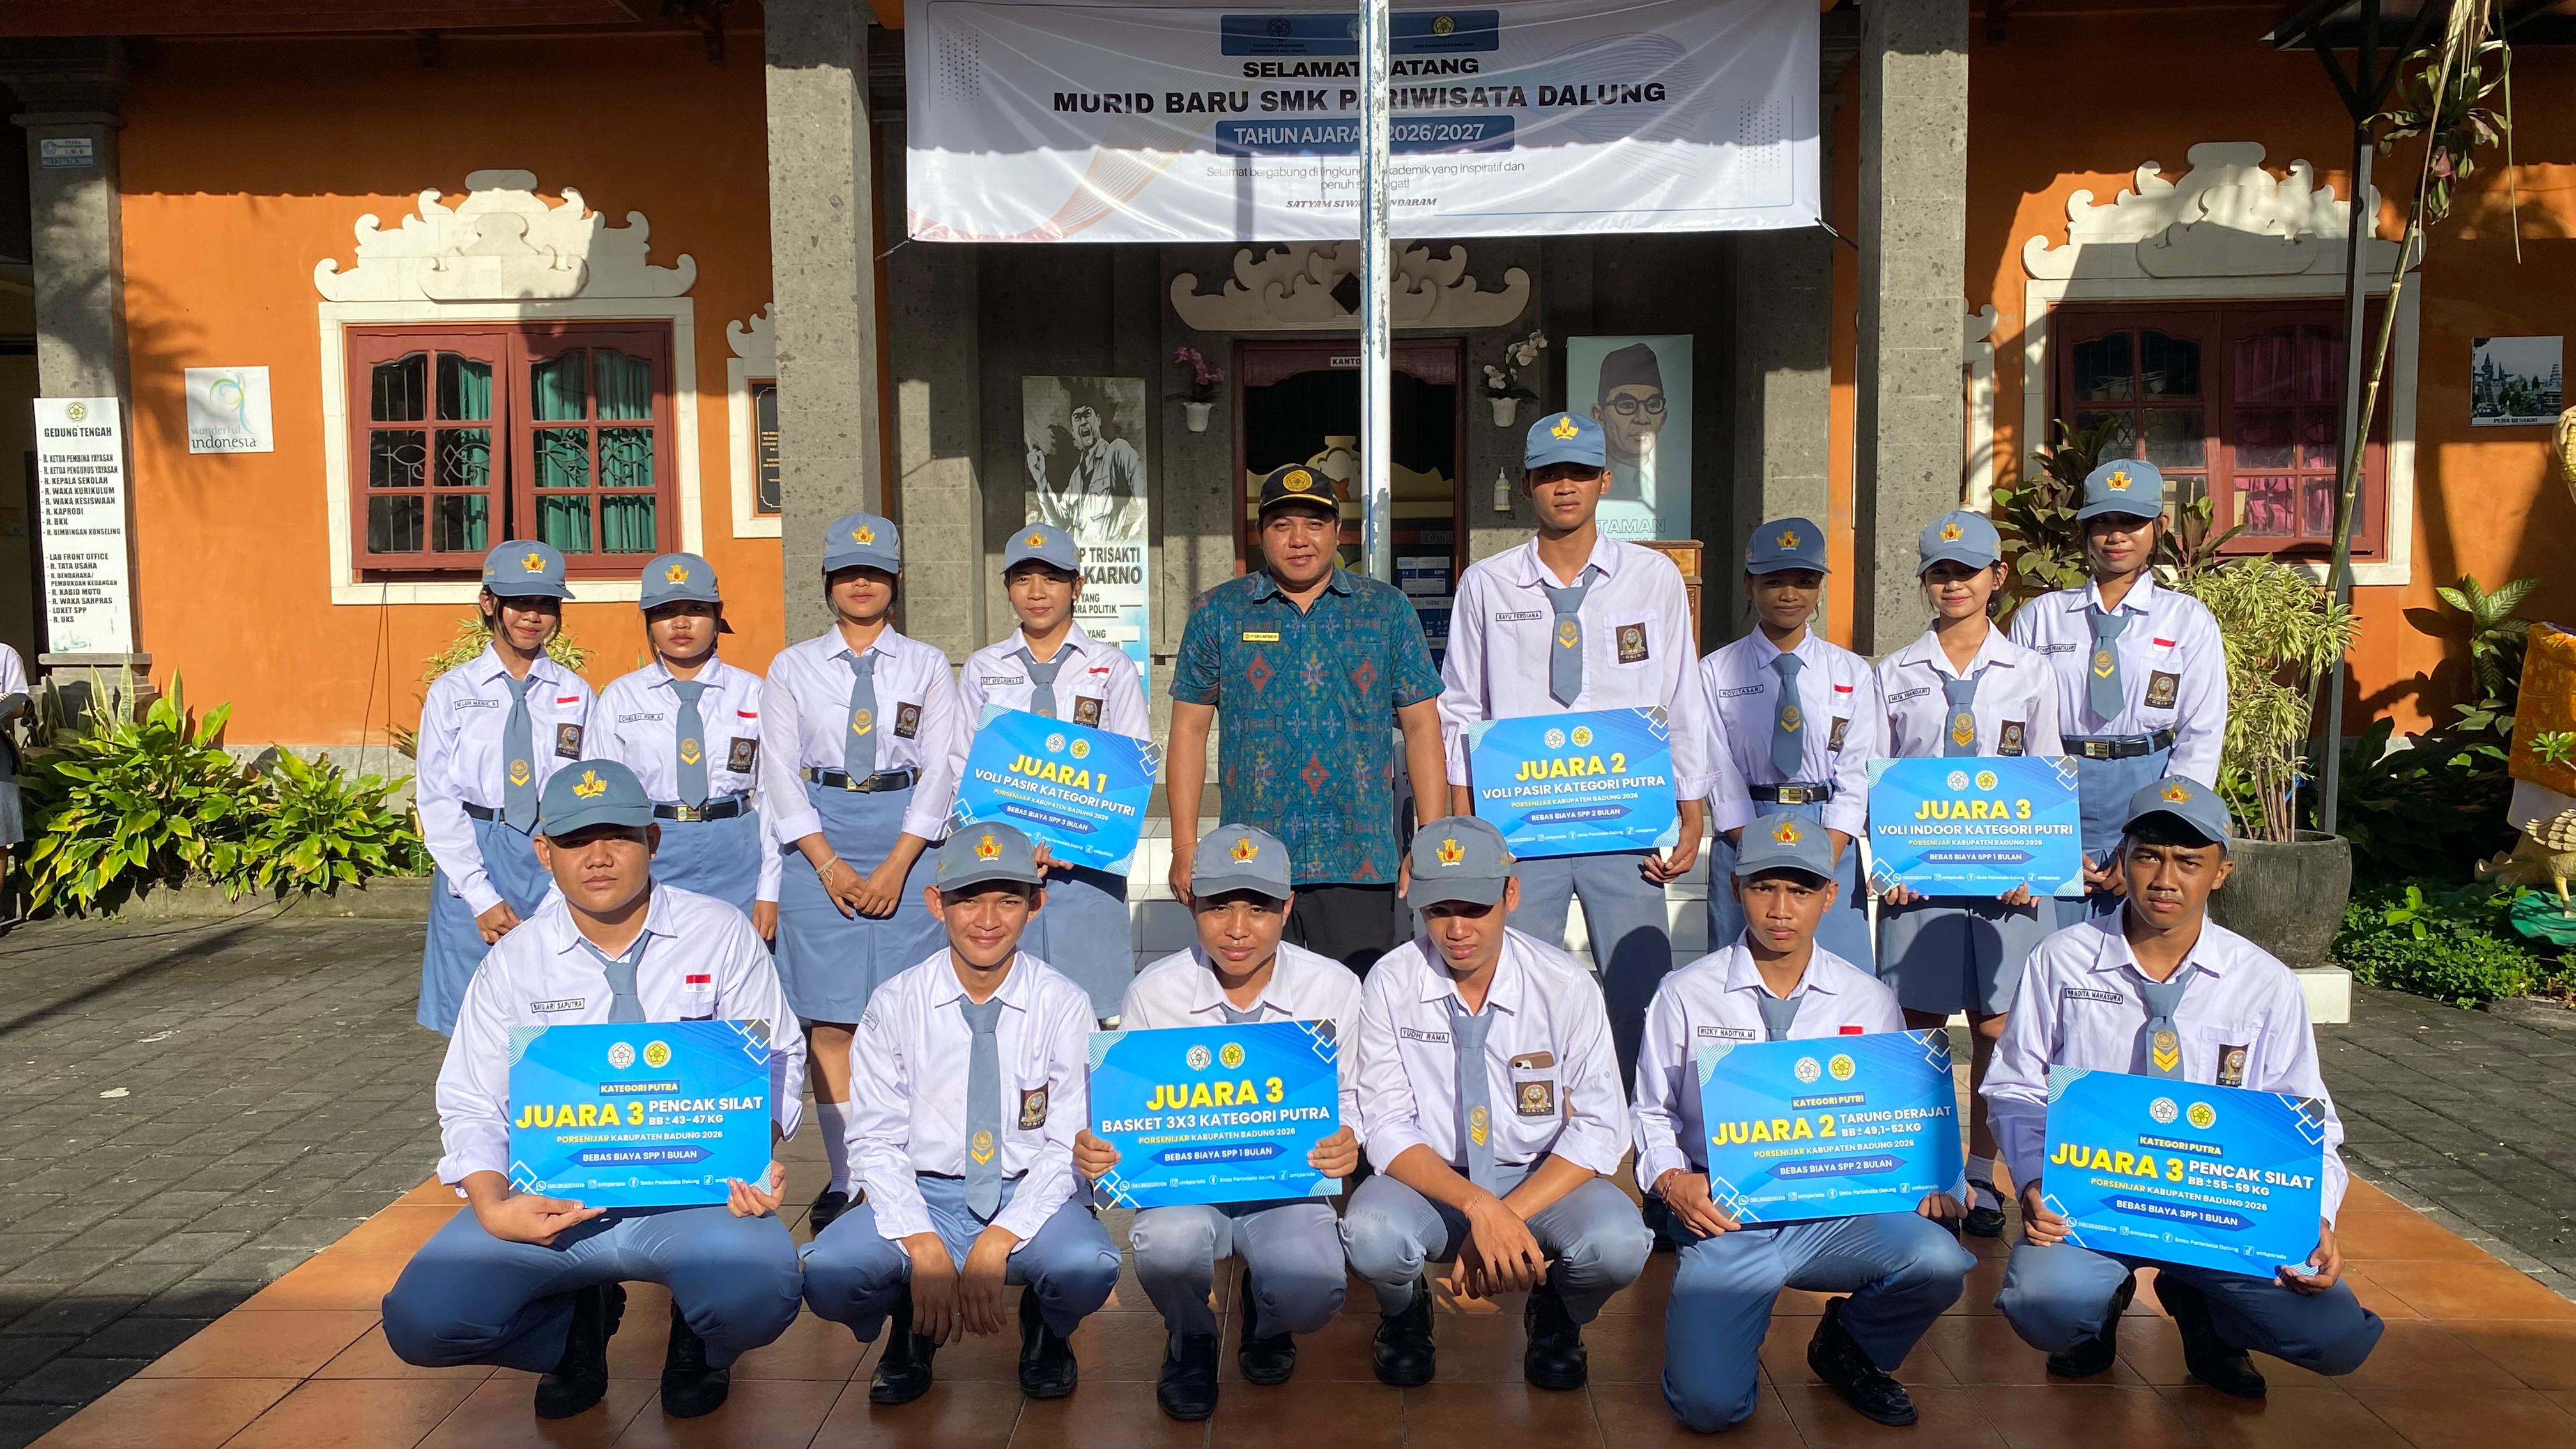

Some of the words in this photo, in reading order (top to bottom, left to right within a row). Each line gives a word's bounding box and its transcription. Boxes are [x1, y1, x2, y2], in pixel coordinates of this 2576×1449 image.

[1243, 61, 1360, 78] SELAMAT
[1389, 58, 1479, 75] ATANG
[1054, 92, 1154, 114] MURID
[1165, 91, 1248, 113] BARU
[1261, 89, 1328, 112] SMK
[1538, 82, 1666, 107] DALUNG
[1234, 126, 1300, 144] TAHUN
[1301, 125, 1360, 144] AJARA
[1207, 167, 1248, 177] Selamat
[1250, 167, 1307, 179] bergabung
[1309, 167, 1318, 177] di
[1389, 164, 1430, 175] kademik
[1432, 165, 1458, 176] yang
[1460, 162, 1503, 174] inspiratif
[1504, 161, 1524, 171] dan
[1321, 180, 1354, 192] penuh
[1389, 198, 1438, 206] NDARAM
[45, 428, 77, 437] GEDUNG
[80, 427, 112, 436] TENGAH
[192, 424, 241, 434] wonderful
[192, 435, 257, 448] indonesia
[1597, 519, 1666, 533] TAMAN
[1089, 547, 1140, 563] TRISAKTI
[1084, 565, 1143, 585] KARNO
[1081, 594, 1100, 602] YANG
[1089, 605, 1117, 614] POLITIK
[1087, 629, 1106, 638] YANG
[1722, 687, 1761, 696] NOVITASARI
[1009, 754, 1091, 790] JUARA
[1096, 773, 1107, 793] 1
[1515, 755, 1606, 781] JUARA
[1611, 753, 1627, 773] 2
[975, 769, 1002, 784] VOLI
[1003, 778, 1038, 792] PASIR
[1039, 785, 1100, 808] KATEGORI
[1100, 799, 1135, 816] PUTRI
[1482, 787, 1512, 799] VOLI
[1514, 784, 1551, 797] PASIR
[1554, 779, 1620, 794] KATEGORI
[1622, 775, 1666, 787] PUTRA
[1914, 799, 2010, 820] JUARA
[2016, 799, 2032, 819] 3
[1878, 825, 1907, 836] VOLI
[1910, 825, 1962, 835] INDOOR
[1965, 824, 2032, 835] KATEGORI
[2034, 824, 2073, 835] PUTRI
[557, 1000, 581, 1009] SAPUTRA
[2092, 991, 2120, 1002] MAHASURA
[1403, 1029, 1423, 1039] YUDHI
[601, 1083, 647, 1094] KATEGORI
[648, 1082, 678, 1092] PUTRA
[1146, 1080, 1259, 1111] JUARA
[1265, 1077, 1284, 1103] 3
[648, 1098, 716, 1113] PENCAK
[719, 1096, 763, 1110] SILAT
[1793, 1096, 1839, 1108] KATEGORI
[1839, 1094, 1864, 1104] PUTRI
[515, 1103, 621, 1129] JUARA
[627, 1101, 645, 1126] 3
[1101, 1117, 1163, 1133] BASKET
[1165, 1114, 1197, 1130] 3X3
[1199, 1110, 1276, 1128] KATEGORI
[1280, 1107, 1330, 1121] PUTRA
[1839, 1112, 1892, 1124] TARUNG
[1894, 1106, 1951, 1121] DERAJAT
[1138, 1134, 1190, 1145] PORSENIJAR
[1191, 1131, 1239, 1142] KABUPATEN
[1241, 1130, 1275, 1138] BADUNG
[1276, 1128, 1296, 1136] 2026
[1712, 1117, 1814, 1146] JUARA
[1818, 1114, 1837, 1138] 2
[1164, 1151, 1193, 1162] BEBAS
[1194, 1150, 1220, 1160] BIAYA
[1222, 1149, 1238, 1159] SPP
[1239, 1148, 1243, 1158] 1
[1244, 1147, 1272, 1157] BULAN
[2139, 1136, 2189, 1149] KATEGORI
[2189, 1142, 2222, 1156] PUTRA
[2050, 1143, 2158, 1179] JUARA
[2165, 1157, 2184, 1182] 3
[2188, 1160, 2261, 1182] PENCAK
[2264, 1170, 2315, 1190] SILAT
